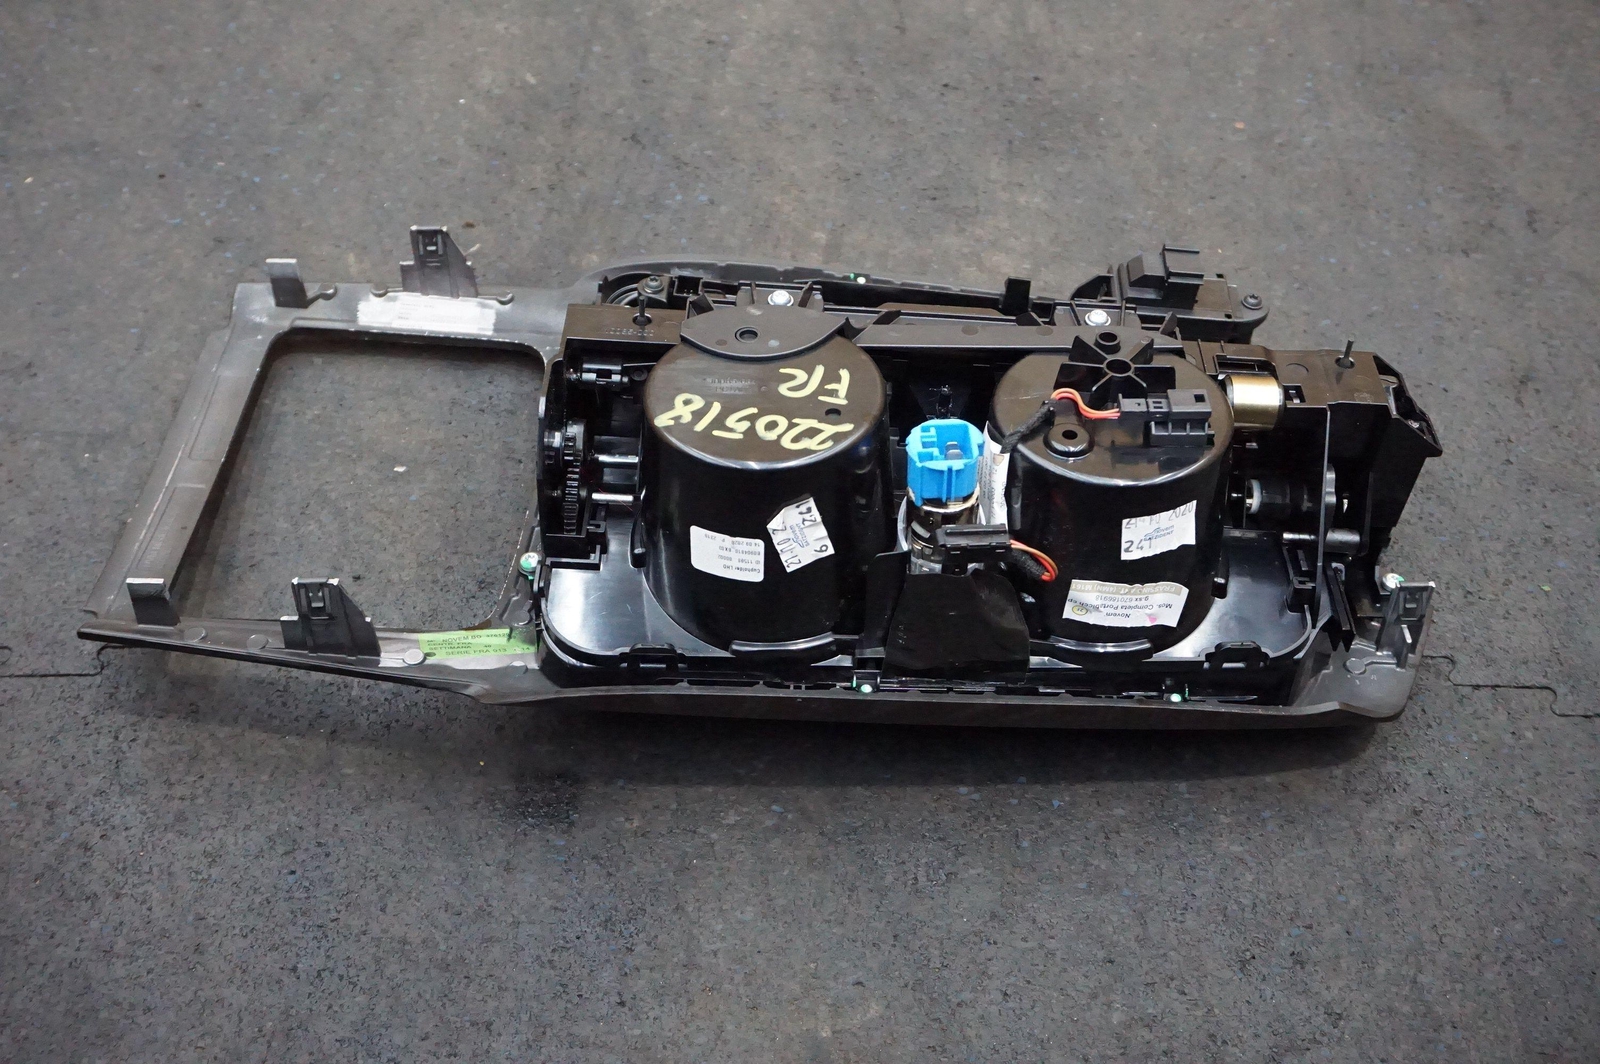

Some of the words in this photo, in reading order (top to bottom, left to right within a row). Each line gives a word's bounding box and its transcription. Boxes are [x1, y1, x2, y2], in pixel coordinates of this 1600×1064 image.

[653, 392, 855, 451] 220518
[735, 566, 761, 574] Cupholder
[1121, 603, 1154, 611] Completa
[442, 635, 469, 643] NOVEM
